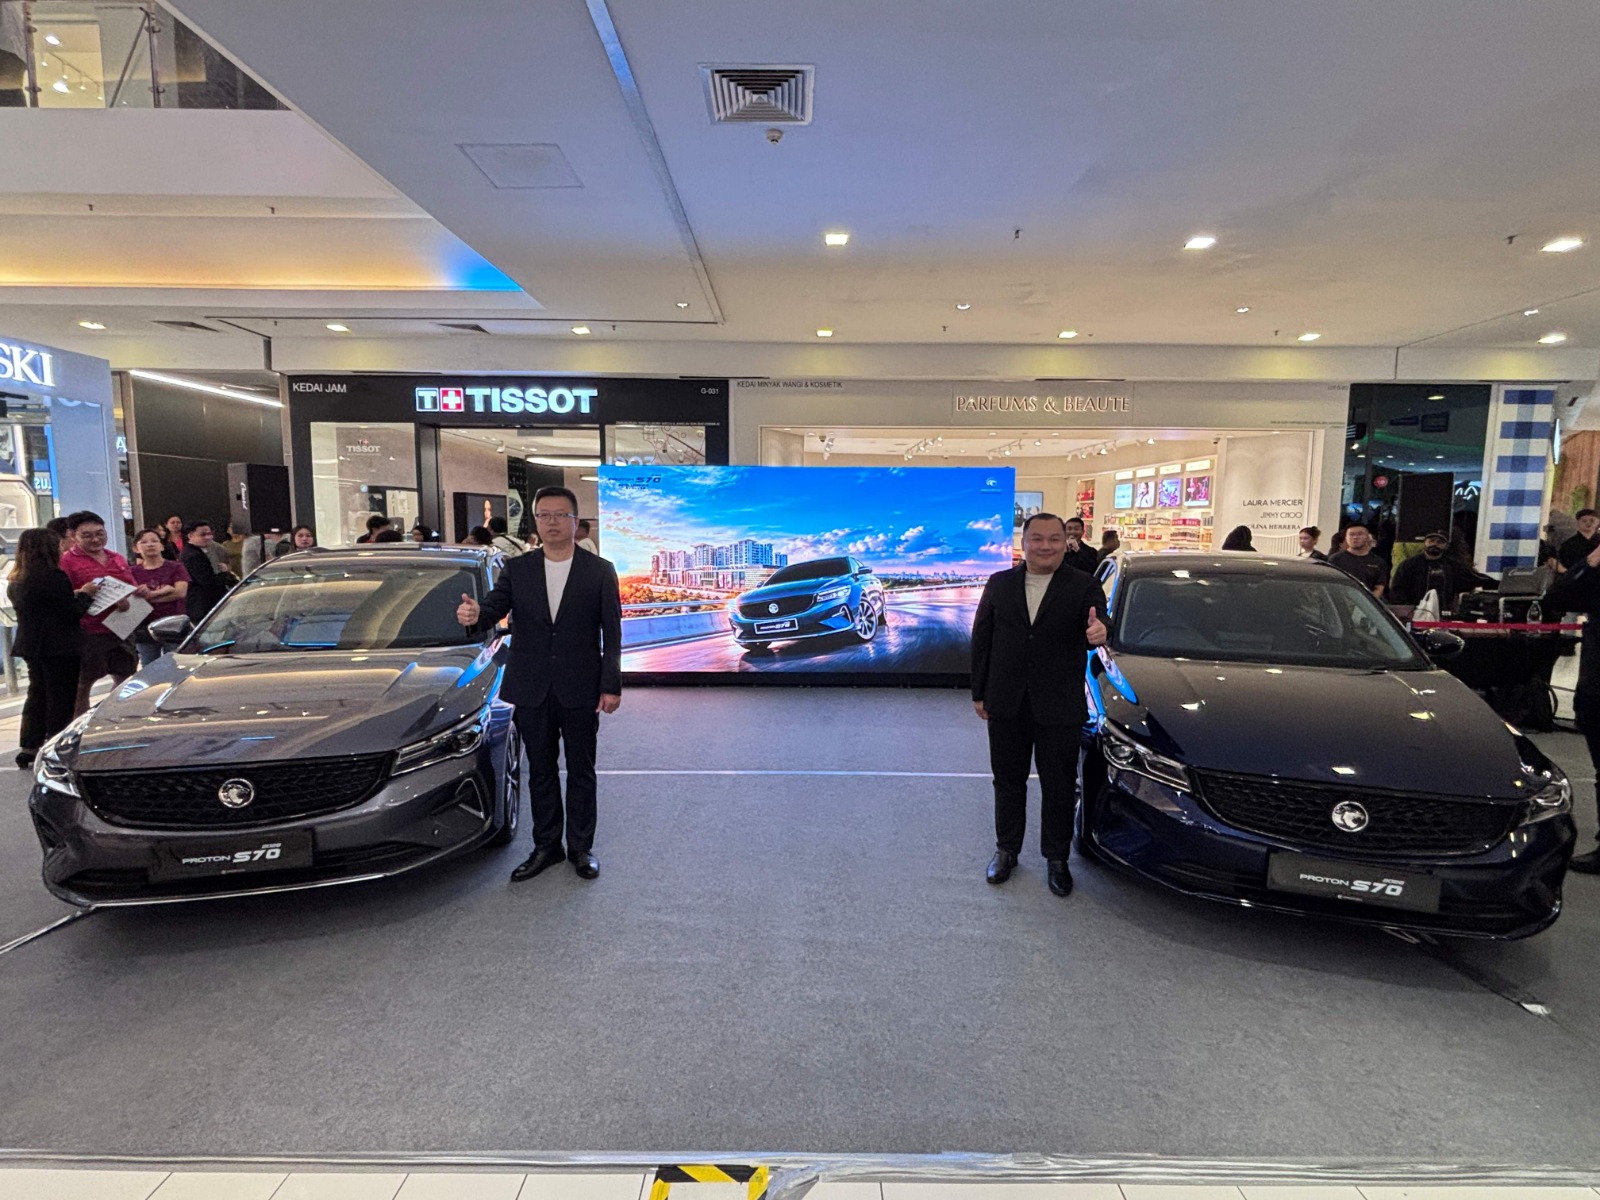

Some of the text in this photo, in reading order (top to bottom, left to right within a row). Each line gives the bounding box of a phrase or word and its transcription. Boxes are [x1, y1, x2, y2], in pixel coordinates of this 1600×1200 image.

[0, 342, 55, 387] SKI
[292, 382, 347, 393] KEDAI JAM
[736, 380, 756, 388] KEDAI
[757, 380, 781, 388] MINYAK
[810, 381, 843, 389] KOSMETIK
[465, 386, 598, 414] TISSOT
[956, 396, 1131, 414] PARFUMS & BEAUTE
[346, 445, 381, 453] TISSOT
[1242, 498, 1304, 507] LAURA MERCIER
[1260, 511, 1303, 519] JIMMY CHOO
[181, 848, 281, 865] PROTON S70
[1299, 873, 1403, 896] PROTON S70
